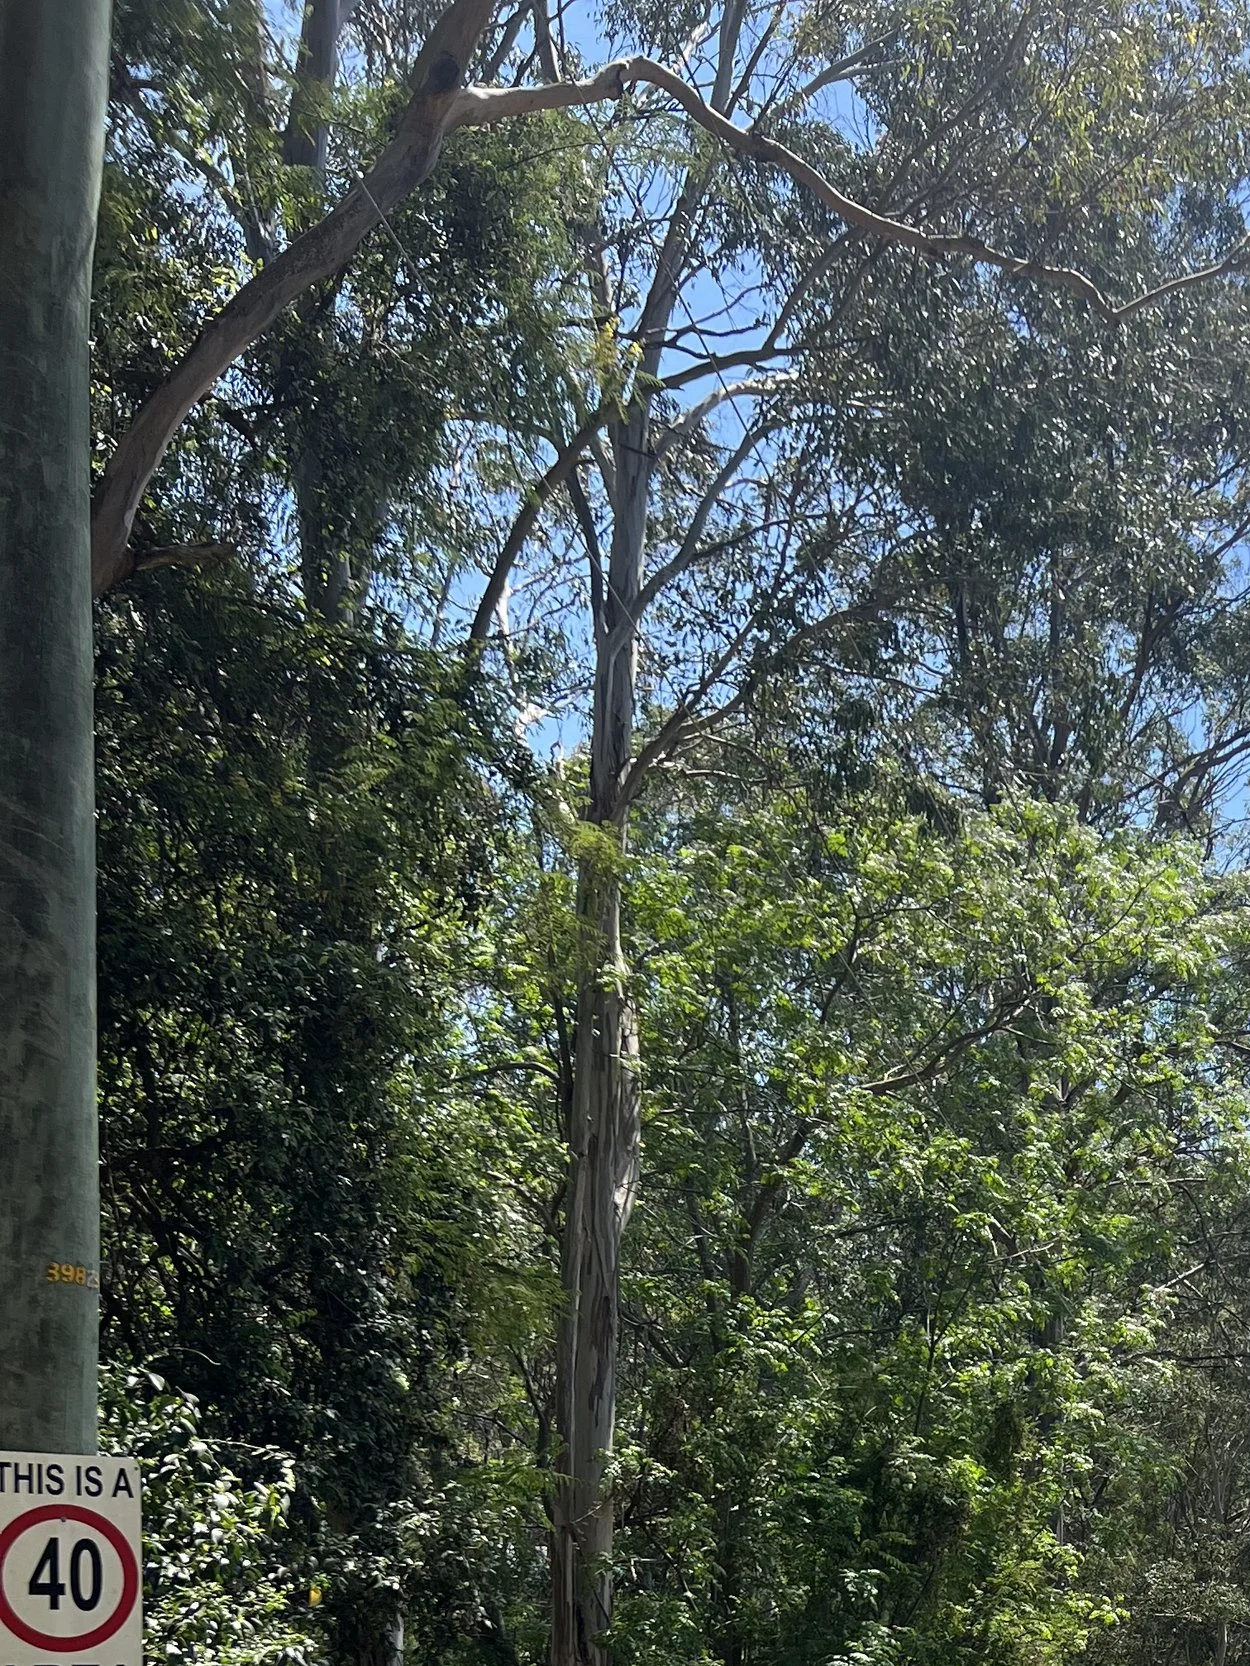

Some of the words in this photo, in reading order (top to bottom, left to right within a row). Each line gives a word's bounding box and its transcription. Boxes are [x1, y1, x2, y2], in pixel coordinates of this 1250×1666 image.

[0, 1462, 65, 1496] THIS
[76, 1465, 103, 1497] IS
[112, 1467, 134, 1499] A
[28, 1536, 103, 1612] 40
